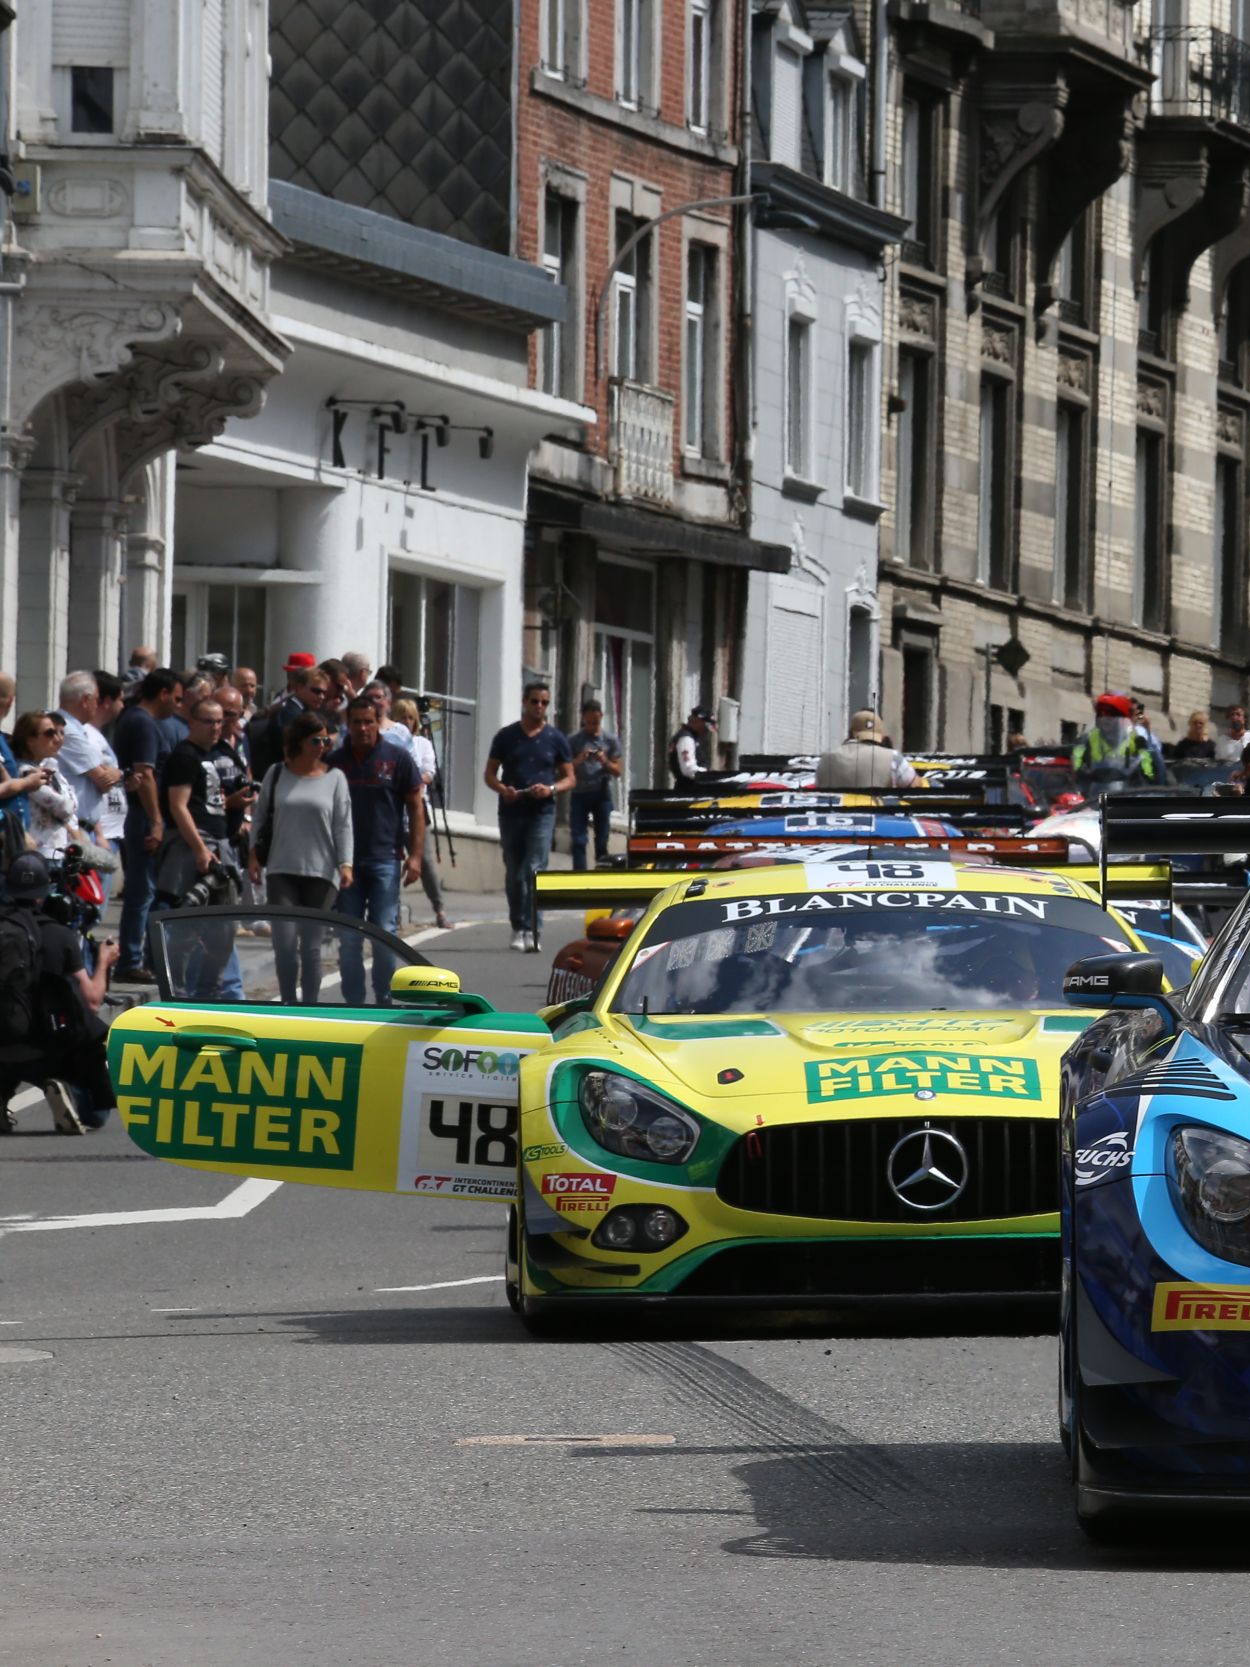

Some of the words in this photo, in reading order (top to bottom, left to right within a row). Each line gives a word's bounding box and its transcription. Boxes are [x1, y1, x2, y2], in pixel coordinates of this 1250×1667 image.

[837, 863, 925, 879] 48
[721, 891, 1049, 924] BLANCPAIN
[426, 980, 459, 989] AMG
[1069, 975, 1110, 986] AMG
[118, 1043, 347, 1101] MANN
[818, 1056, 1026, 1078] MANN
[819, 1071, 1029, 1097] FILTER
[116, 1095, 341, 1155] FILTER
[428, 1100, 518, 1168] 48
[1074, 1149, 1136, 1167] FUCHS
[452, 1184, 467, 1193] GT
[546, 1174, 608, 1192] TOTAL
[555, 1195, 611, 1212] PIRELLI
